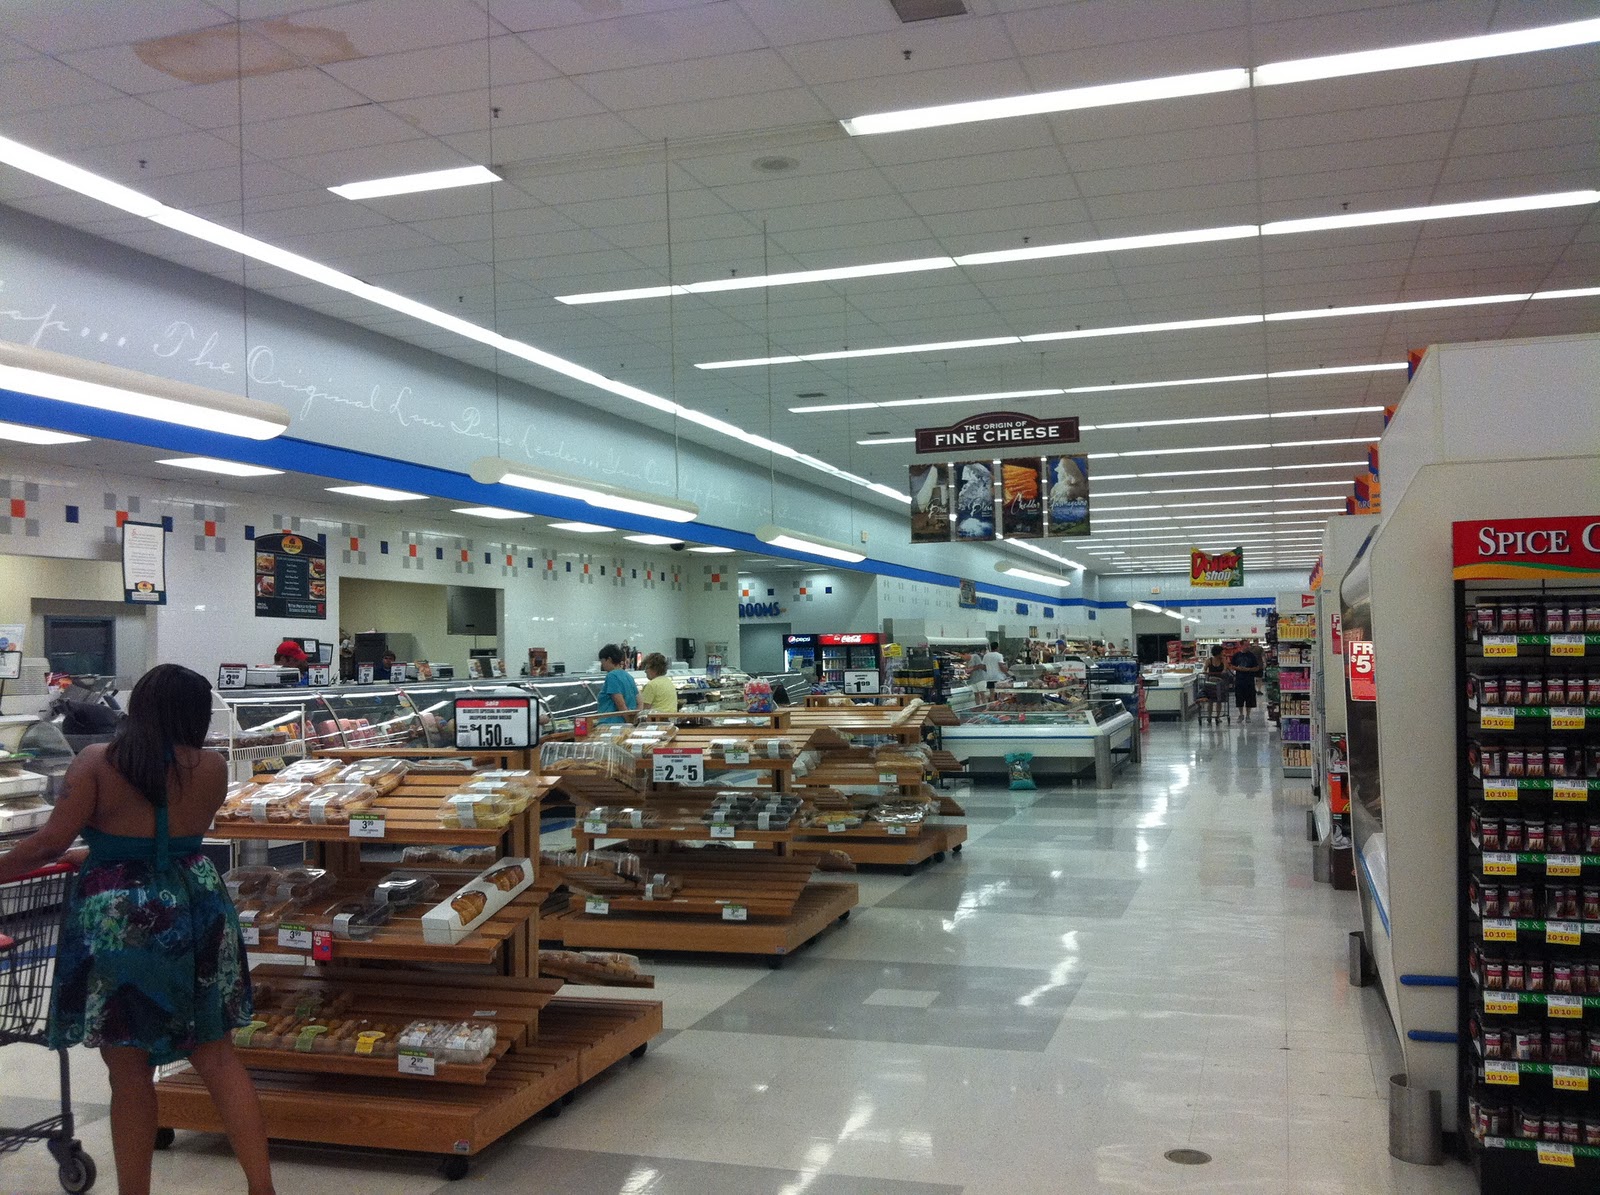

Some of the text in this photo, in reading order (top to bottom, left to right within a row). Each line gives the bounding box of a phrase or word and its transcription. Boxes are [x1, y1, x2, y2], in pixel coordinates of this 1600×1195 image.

[153, 320, 235, 374] The
[246, 345, 380, 421] Original
[983, 421, 1013, 430] ORIGIN
[1015, 420, 1028, 428] OF
[935, 425, 1060, 446] FINE CHEESE
[1478, 526, 1570, 556] SPICE
[1204, 570, 1231, 581] shop
[665, 765, 675, 781] 2
